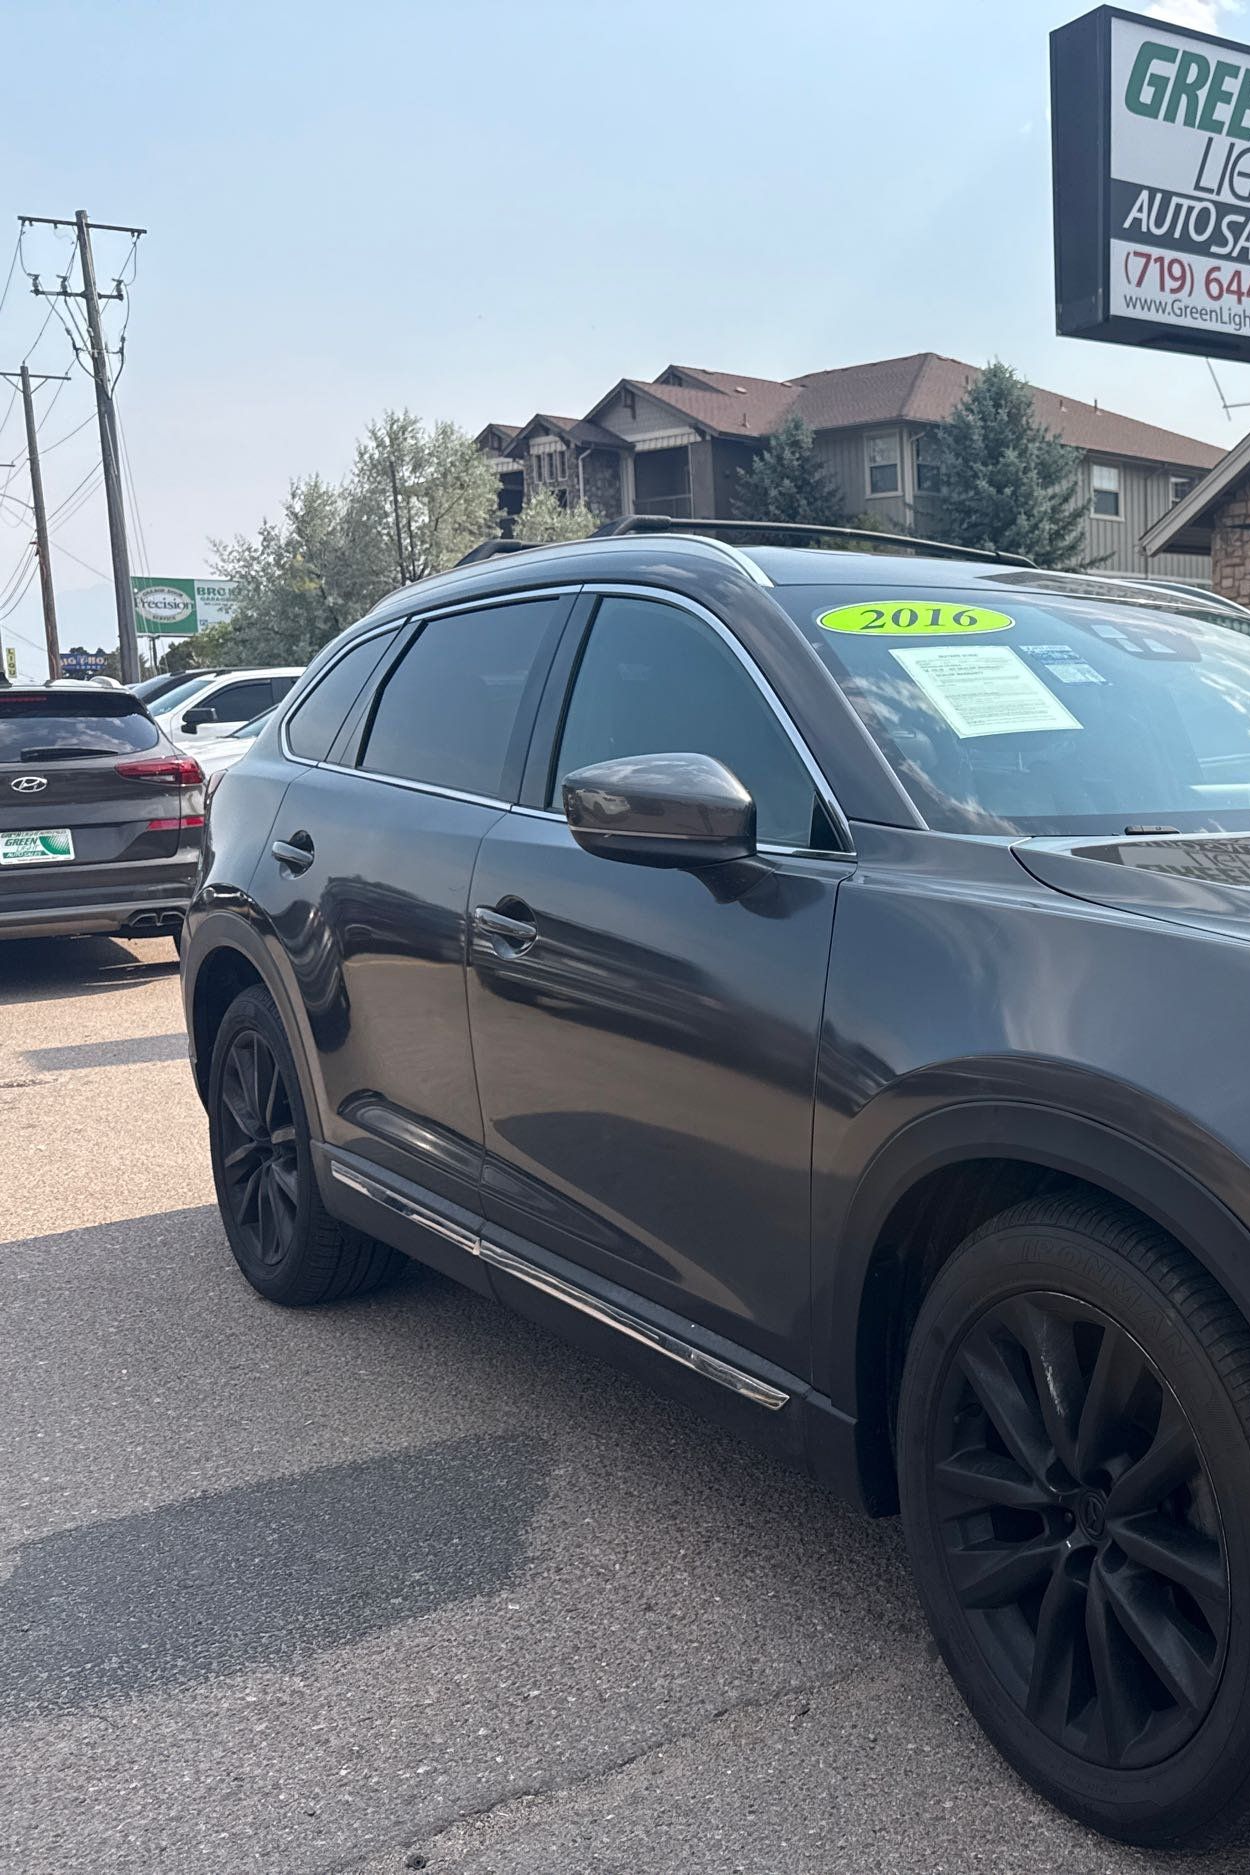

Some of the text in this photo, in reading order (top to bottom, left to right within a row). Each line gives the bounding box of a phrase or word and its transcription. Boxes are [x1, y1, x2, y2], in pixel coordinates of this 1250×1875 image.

[1122, 189, 1217, 242] AUTO
[1124, 250, 1195, 297] (719)
[859, 607, 978, 631] 2016
